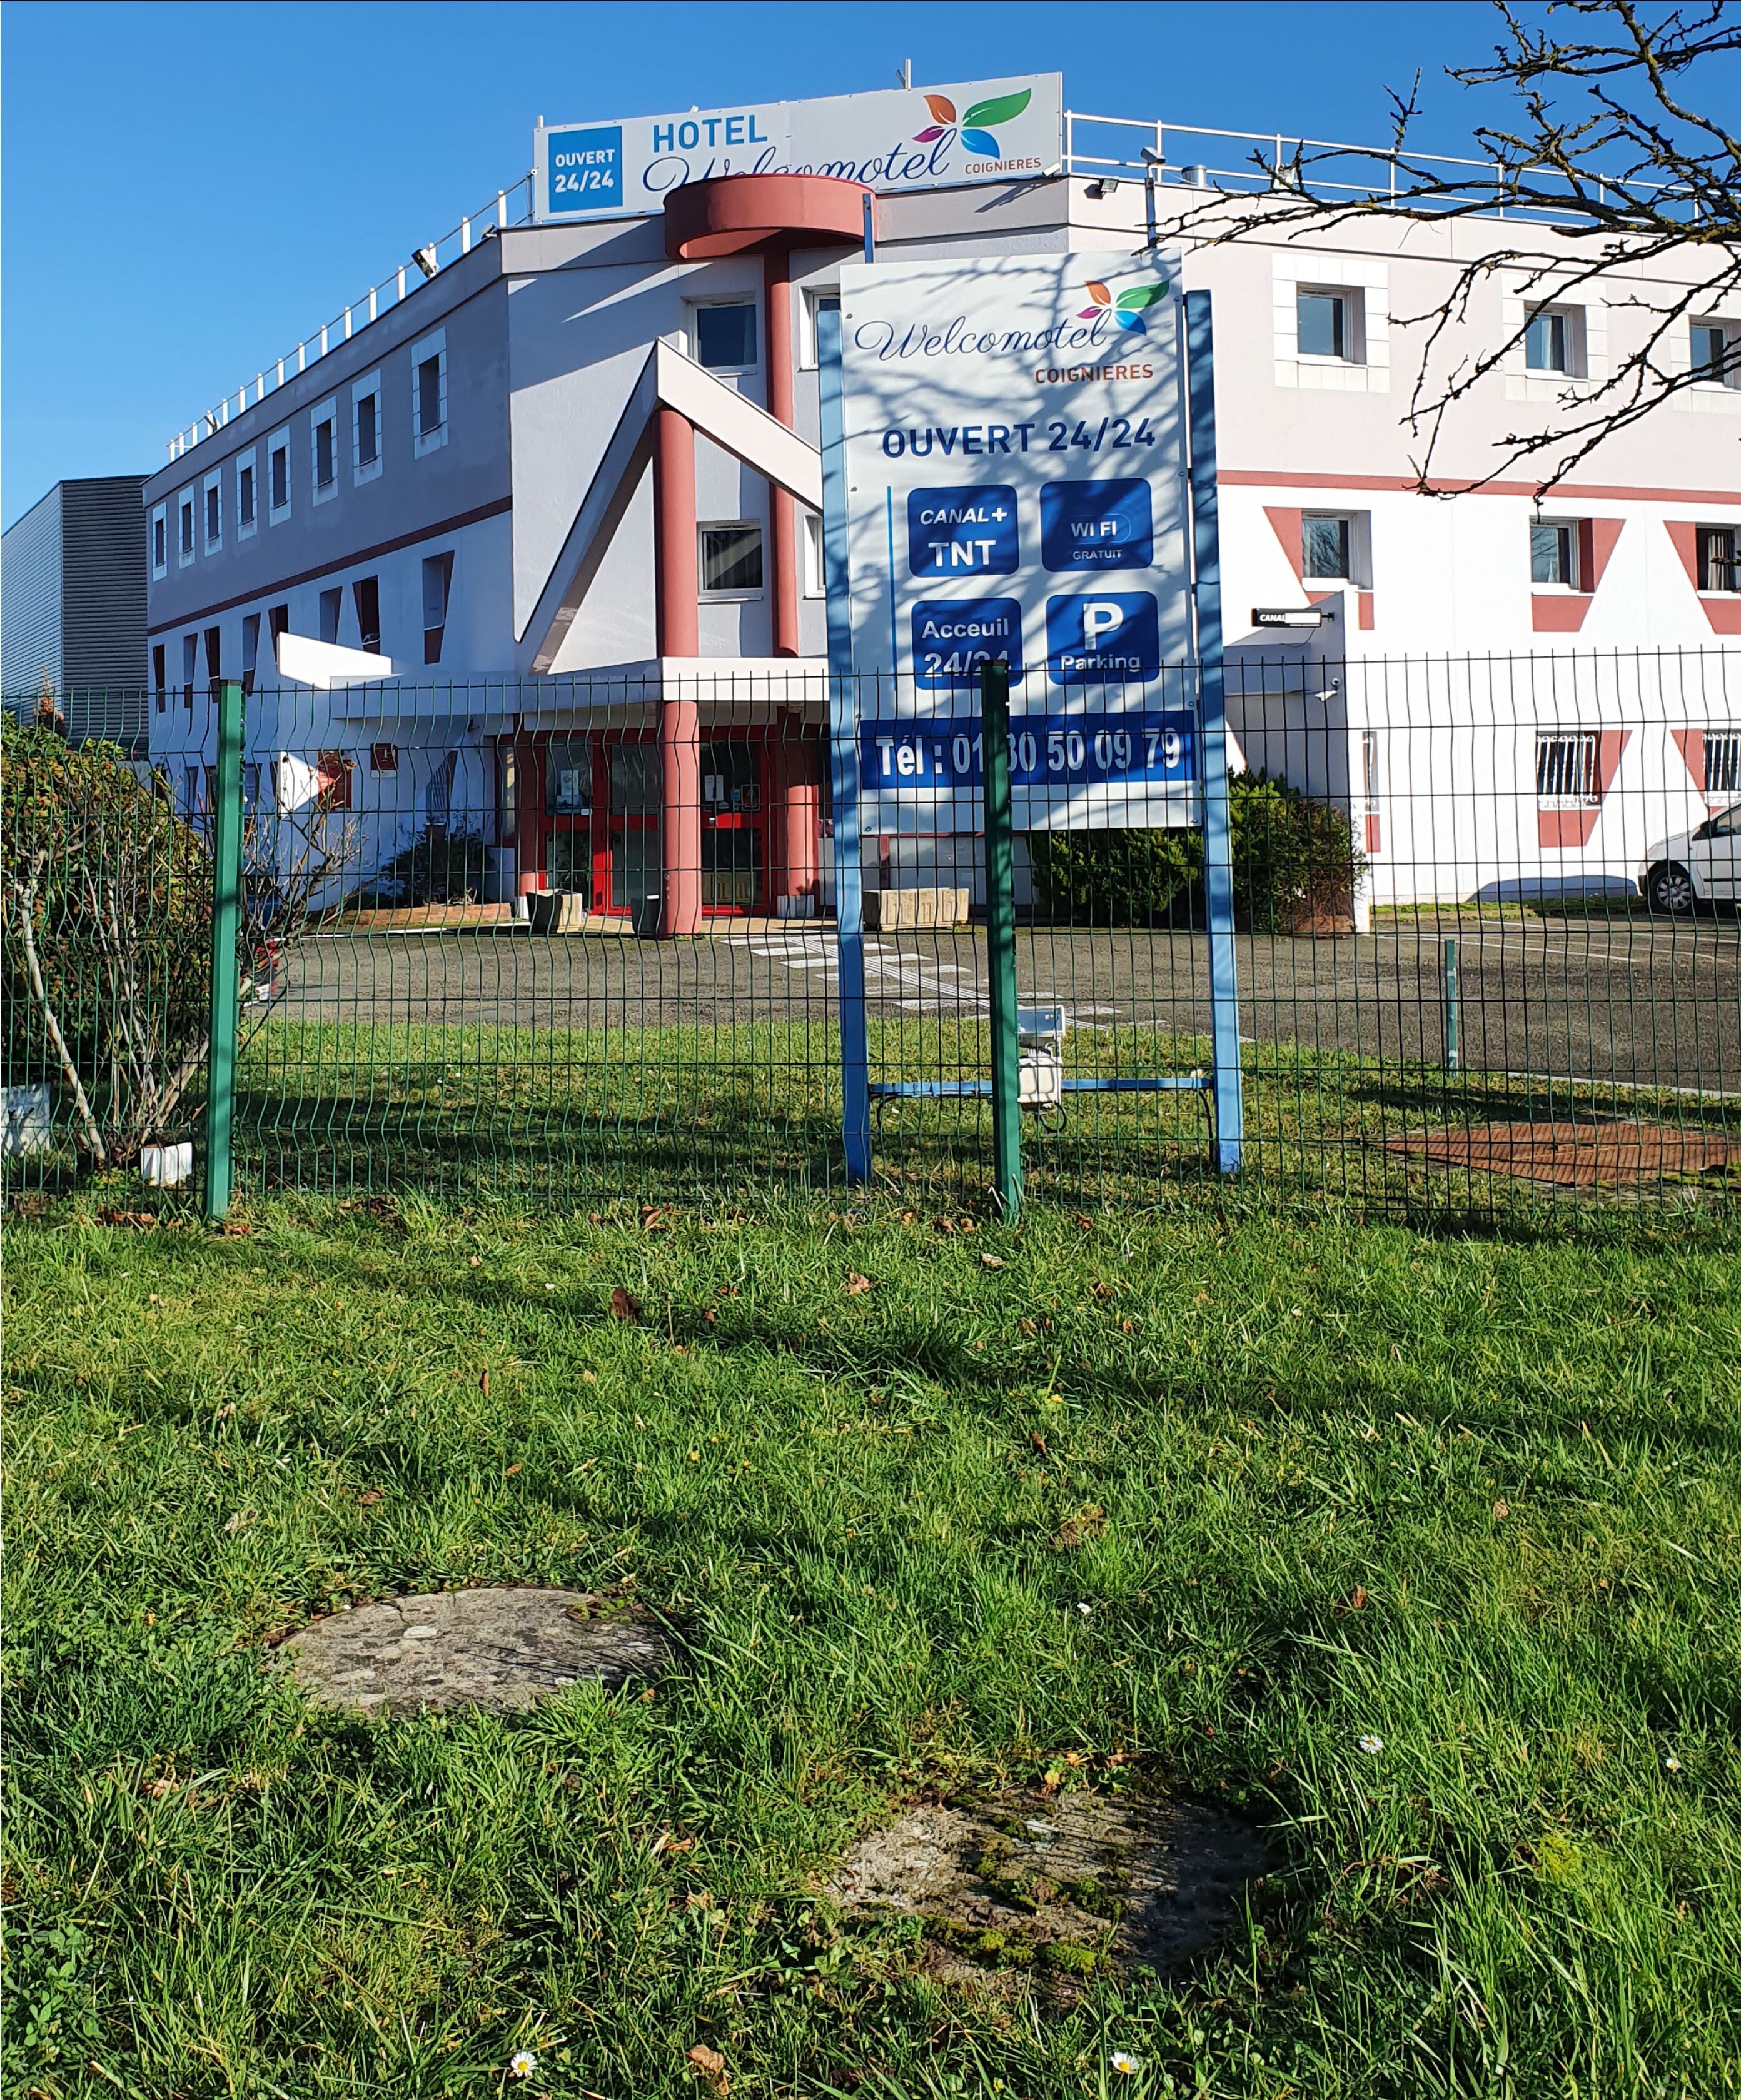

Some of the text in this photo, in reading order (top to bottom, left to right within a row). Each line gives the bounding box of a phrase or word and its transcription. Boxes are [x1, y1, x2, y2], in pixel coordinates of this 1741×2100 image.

[654, 115, 767, 153] HOTEL
[555, 149, 615, 168] OUVERT
[965, 158, 1041, 174] COIGNIERES
[555, 171, 615, 193] 24/24
[855, 308, 1112, 361] Welcomotel
[1034, 363, 1154, 385] COIGNIERES
[882, 417, 1156, 458] OUVERT 24/24
[929, 540, 997, 566] TNT
[1072, 549, 1123, 561] GRATUIT
[922, 618, 1009, 639] Acceuil
[1082, 602, 1124, 651] P
[1061, 654, 1141, 673] Parking
[952, 732, 983, 773] 01
[1047, 730, 1084, 771] 50
[1094, 728, 1131, 769] 09
[1142, 726, 1181, 768] 79
